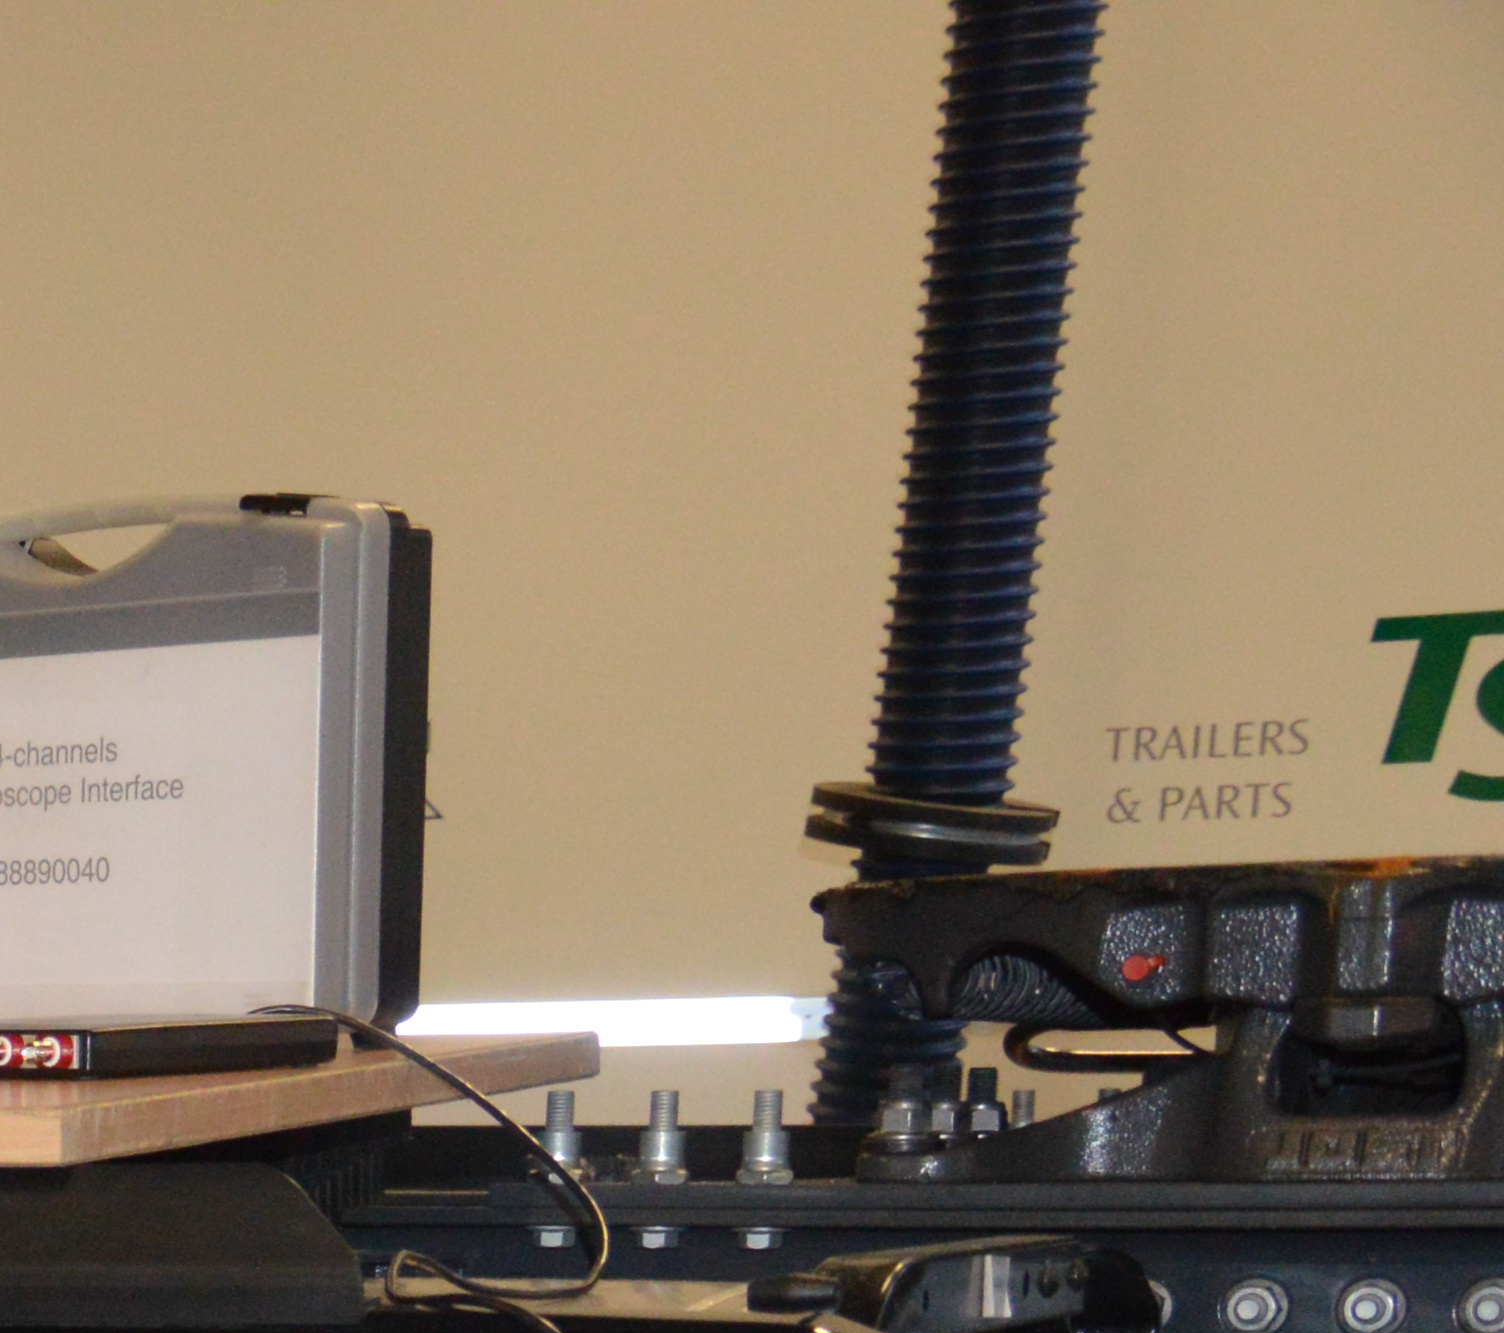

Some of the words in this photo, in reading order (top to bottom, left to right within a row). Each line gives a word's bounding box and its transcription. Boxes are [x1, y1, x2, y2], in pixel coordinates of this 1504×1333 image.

[1369, 609, 1504, 803] T
[1105, 718, 1310, 763] TRAILERS
[80, 774, 185, 803] Interface
[1106, 788, 1140, 824] &
[1157, 782, 1294, 823] PARTS
